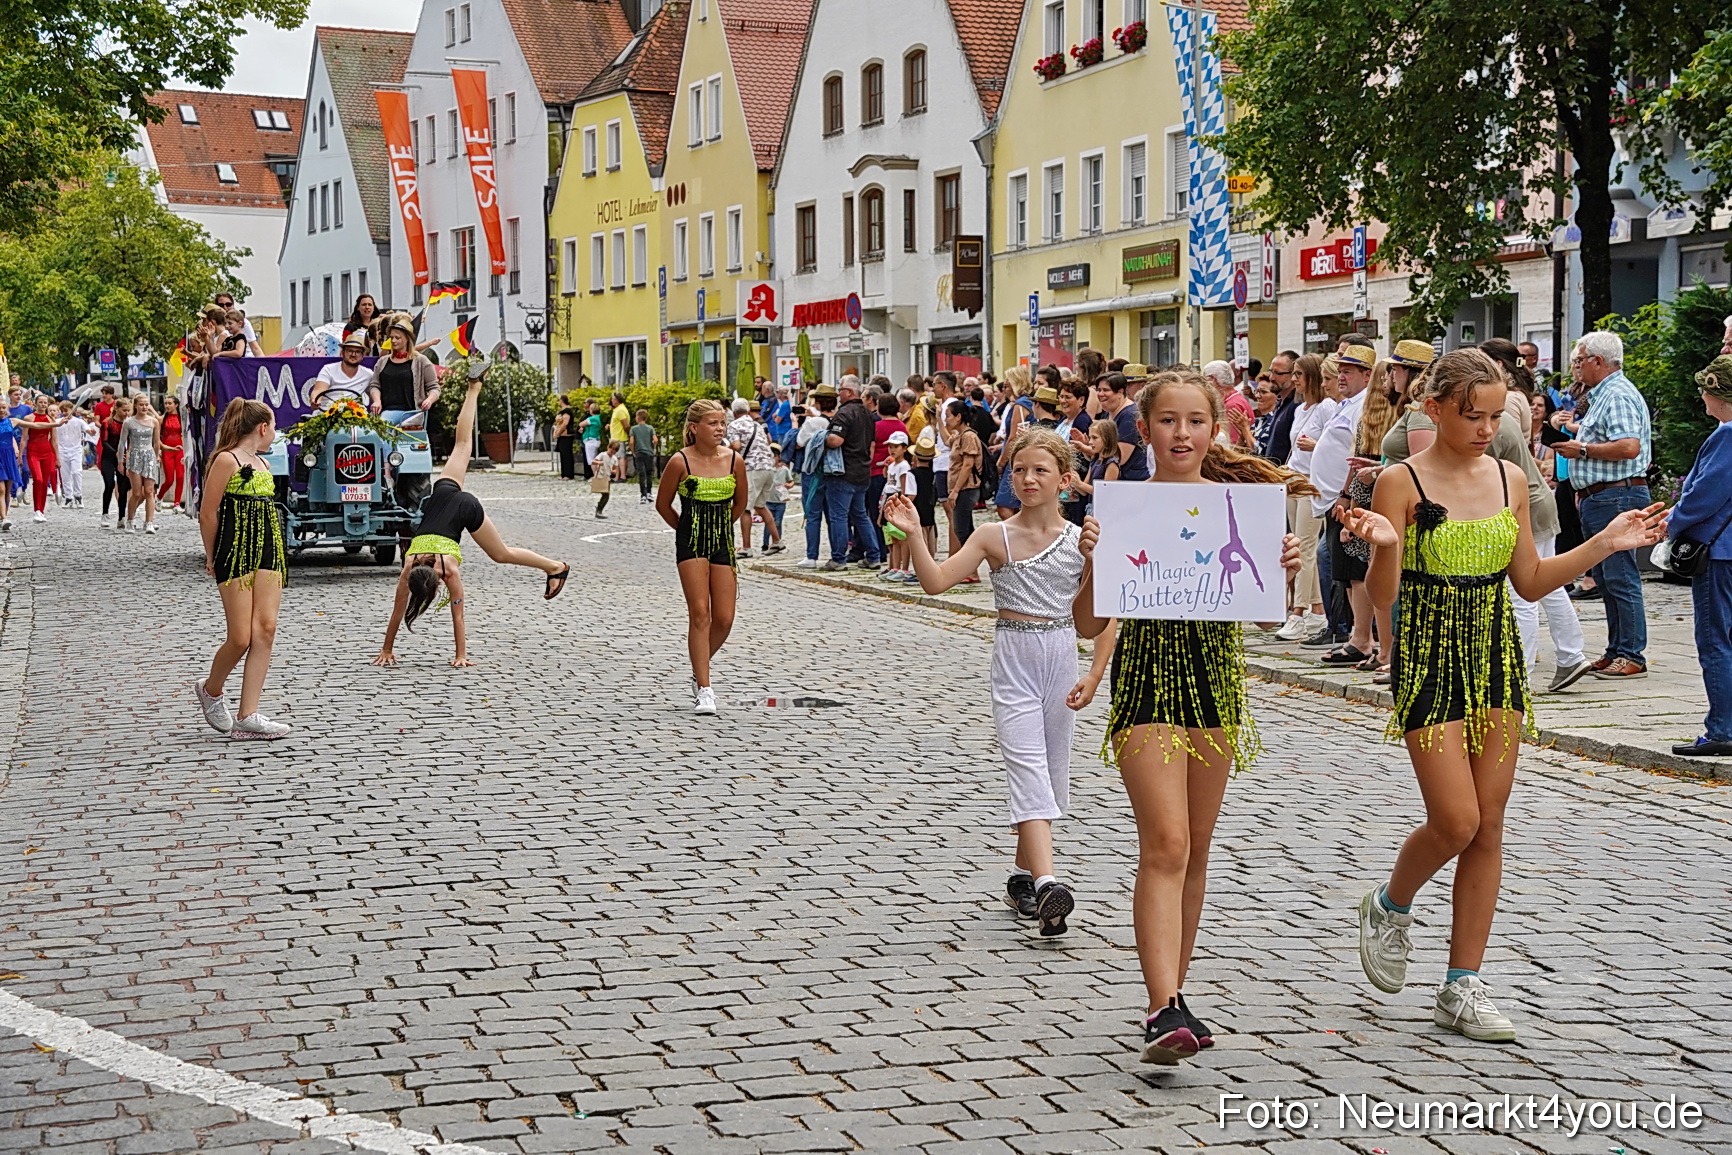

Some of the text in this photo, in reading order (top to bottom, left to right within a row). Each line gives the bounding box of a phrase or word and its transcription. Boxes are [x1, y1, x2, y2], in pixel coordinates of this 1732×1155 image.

[464, 126, 498, 209] SALE
[597, 195, 658, 224] HOTEL Lehmeier
[1264, 231, 1273, 298] KINO
[698, 293, 704, 320] P
[791, 298, 847, 327] APOTHEK
[344, 493, 369, 501] 07031
[1138, 560, 1196, 585] Magic
[1119, 572, 1233, 614] Butterflys
